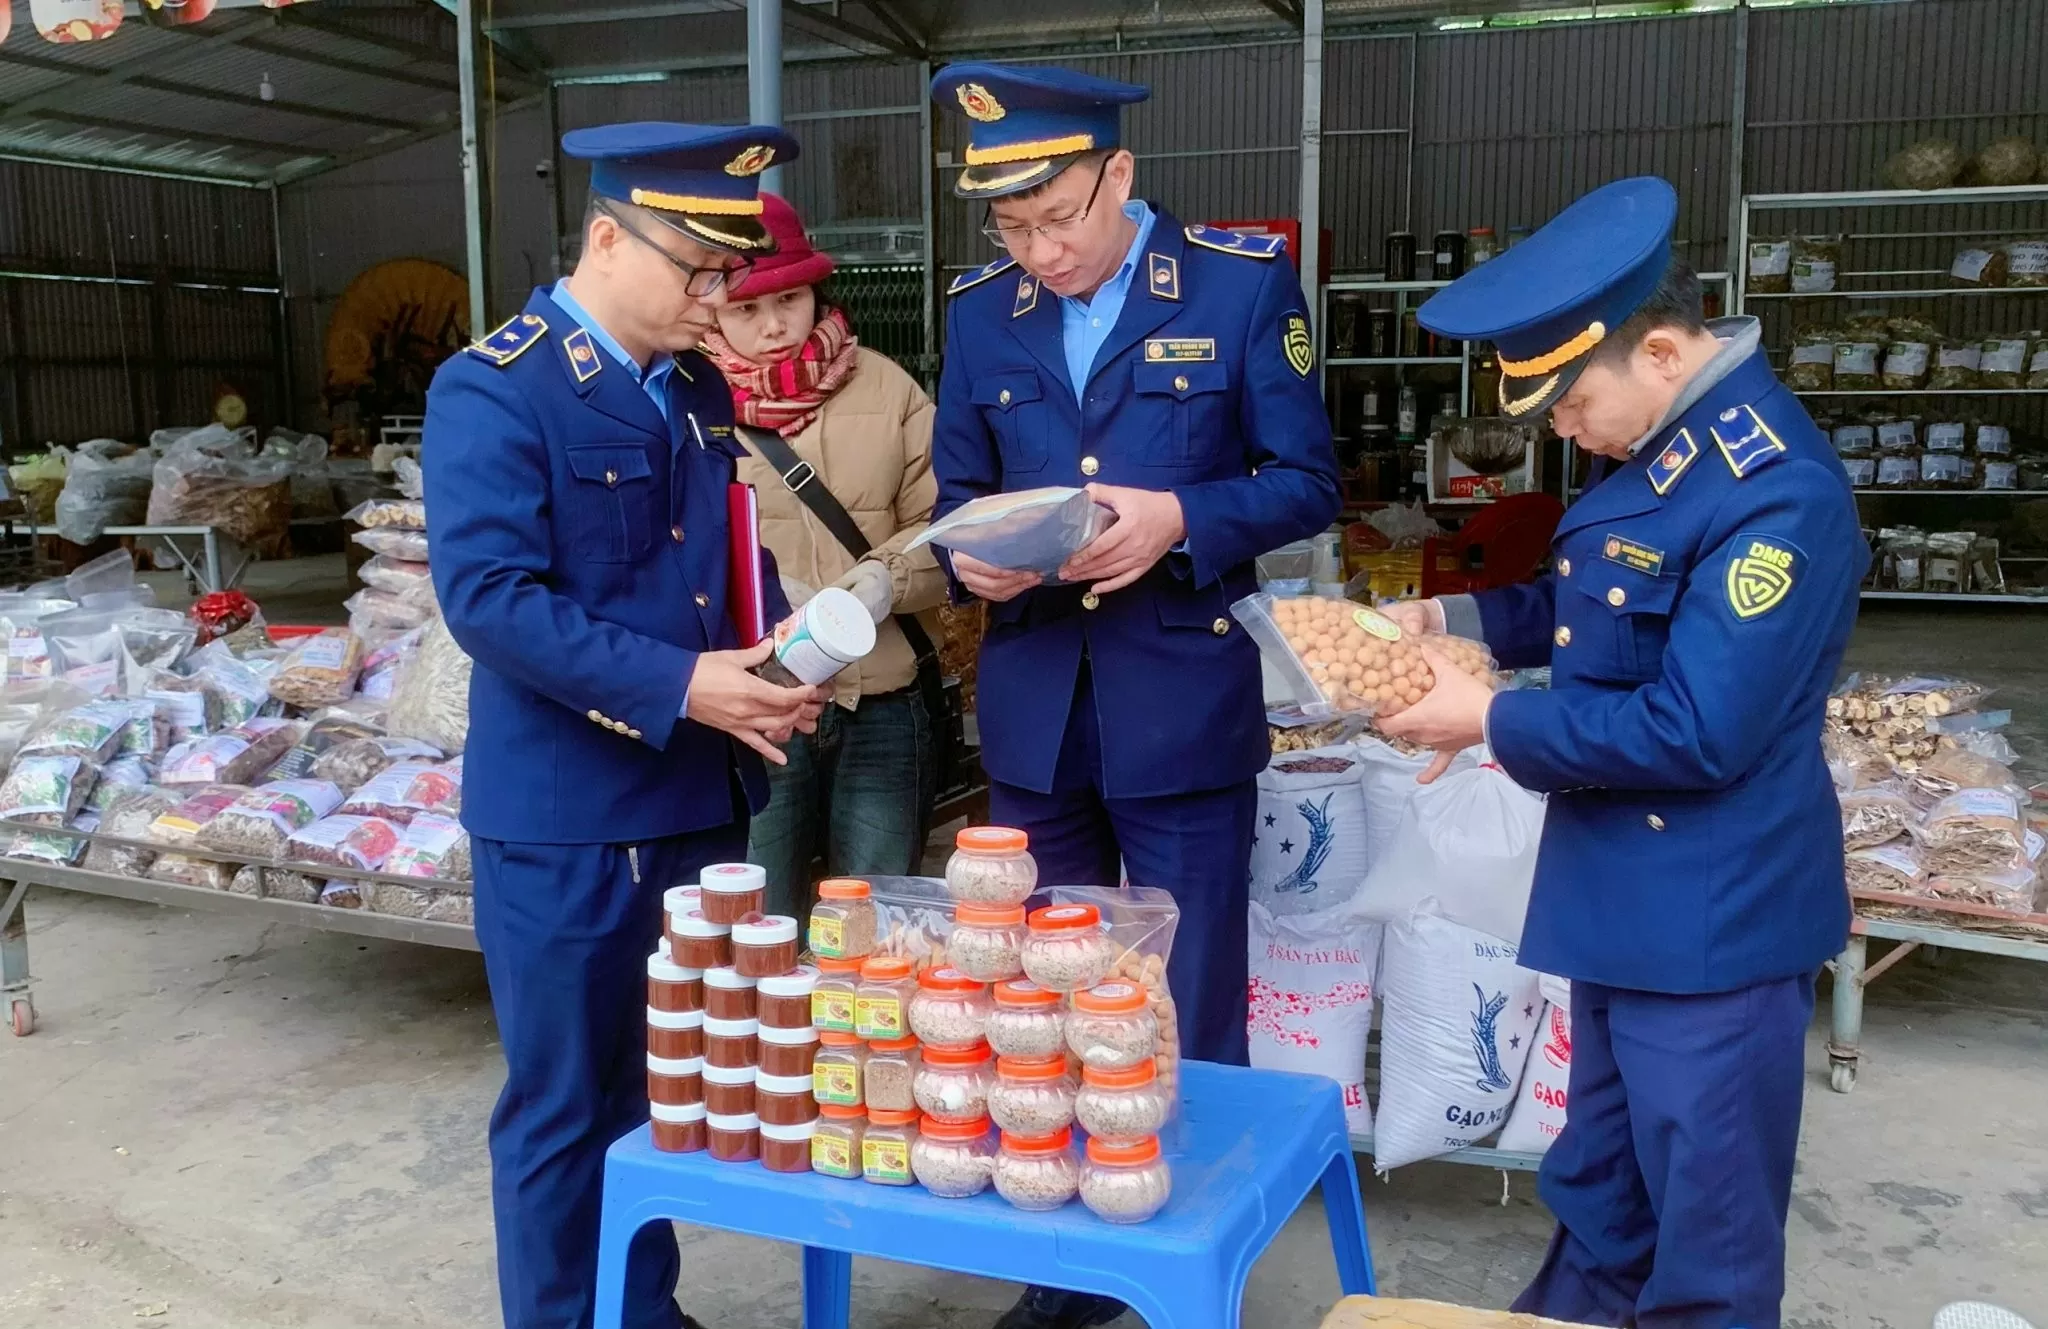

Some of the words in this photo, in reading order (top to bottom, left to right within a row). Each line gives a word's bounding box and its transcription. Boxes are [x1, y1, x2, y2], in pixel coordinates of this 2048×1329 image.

[1748, 541, 1794, 569] DMS
[1534, 1081, 1567, 1108] GẠO
[1446, 1105, 1485, 1129] GẠO
